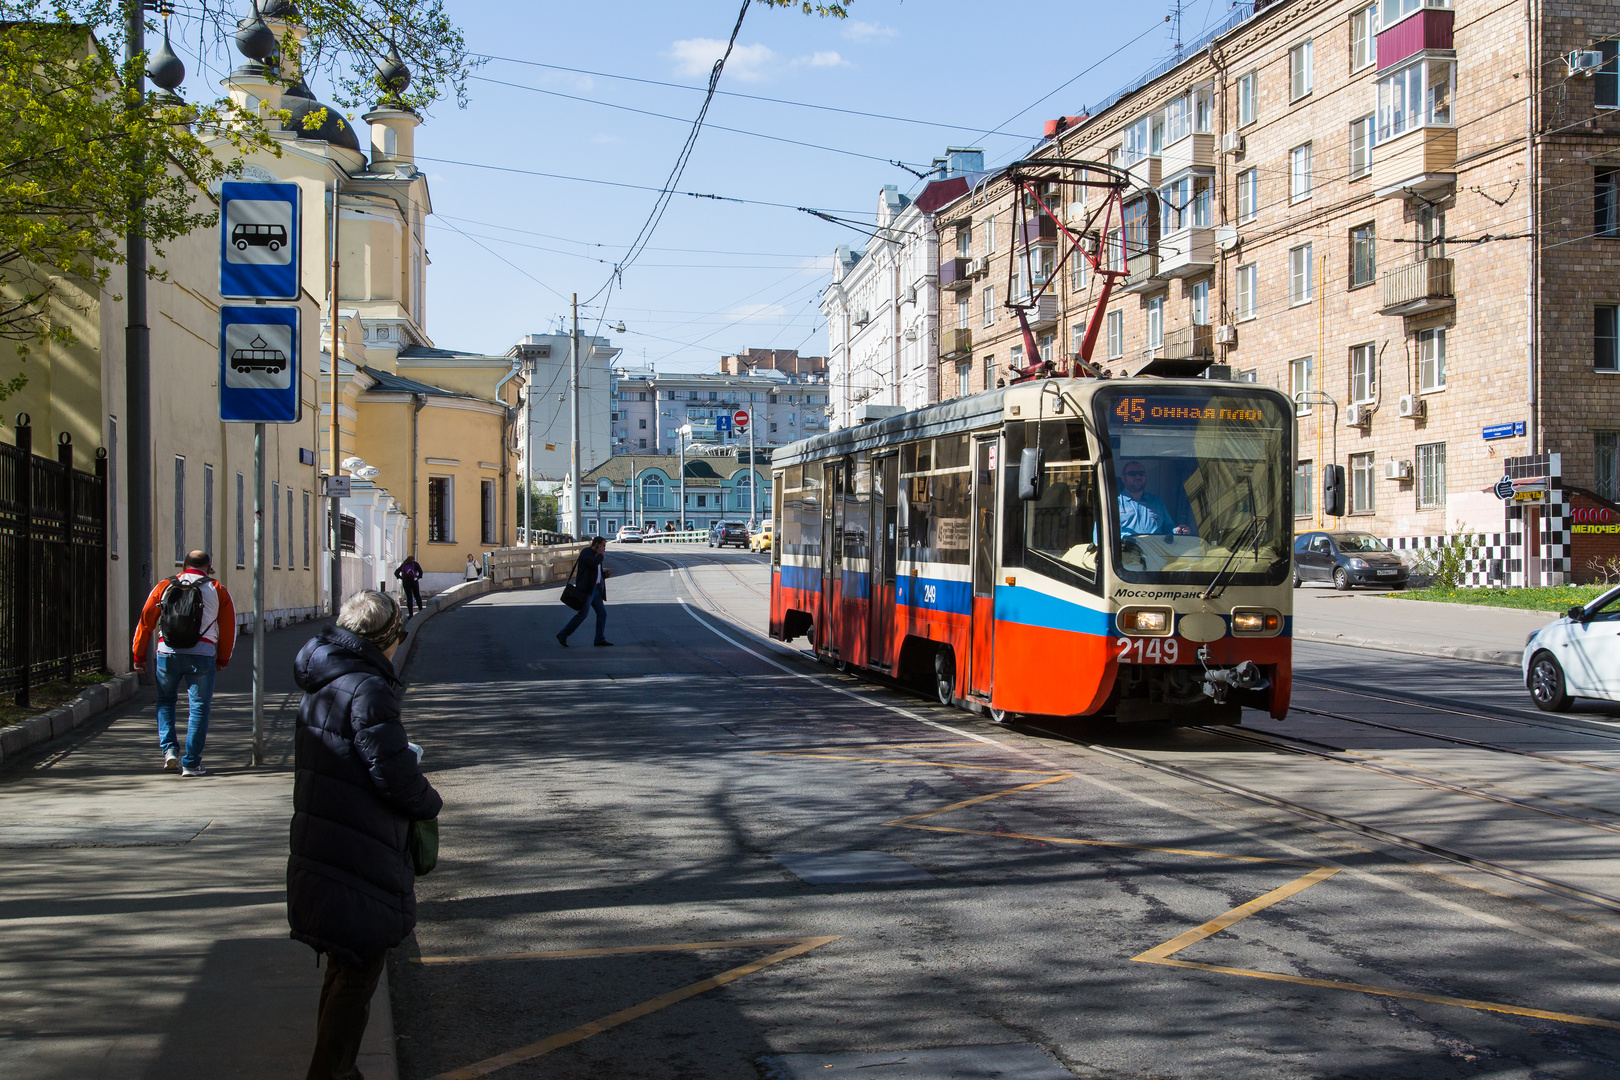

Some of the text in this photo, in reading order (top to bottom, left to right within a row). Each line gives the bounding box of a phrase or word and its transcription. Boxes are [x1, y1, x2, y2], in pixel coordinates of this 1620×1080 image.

[1116, 398, 1145, 422] 45
[1151, 406, 1216, 419] онная
[1570, 508, 1612, 524] 1000
[924, 585, 936, 603] 2149
[1114, 588, 1203, 601] Мосгортранс
[1116, 637, 1178, 664] 2149
